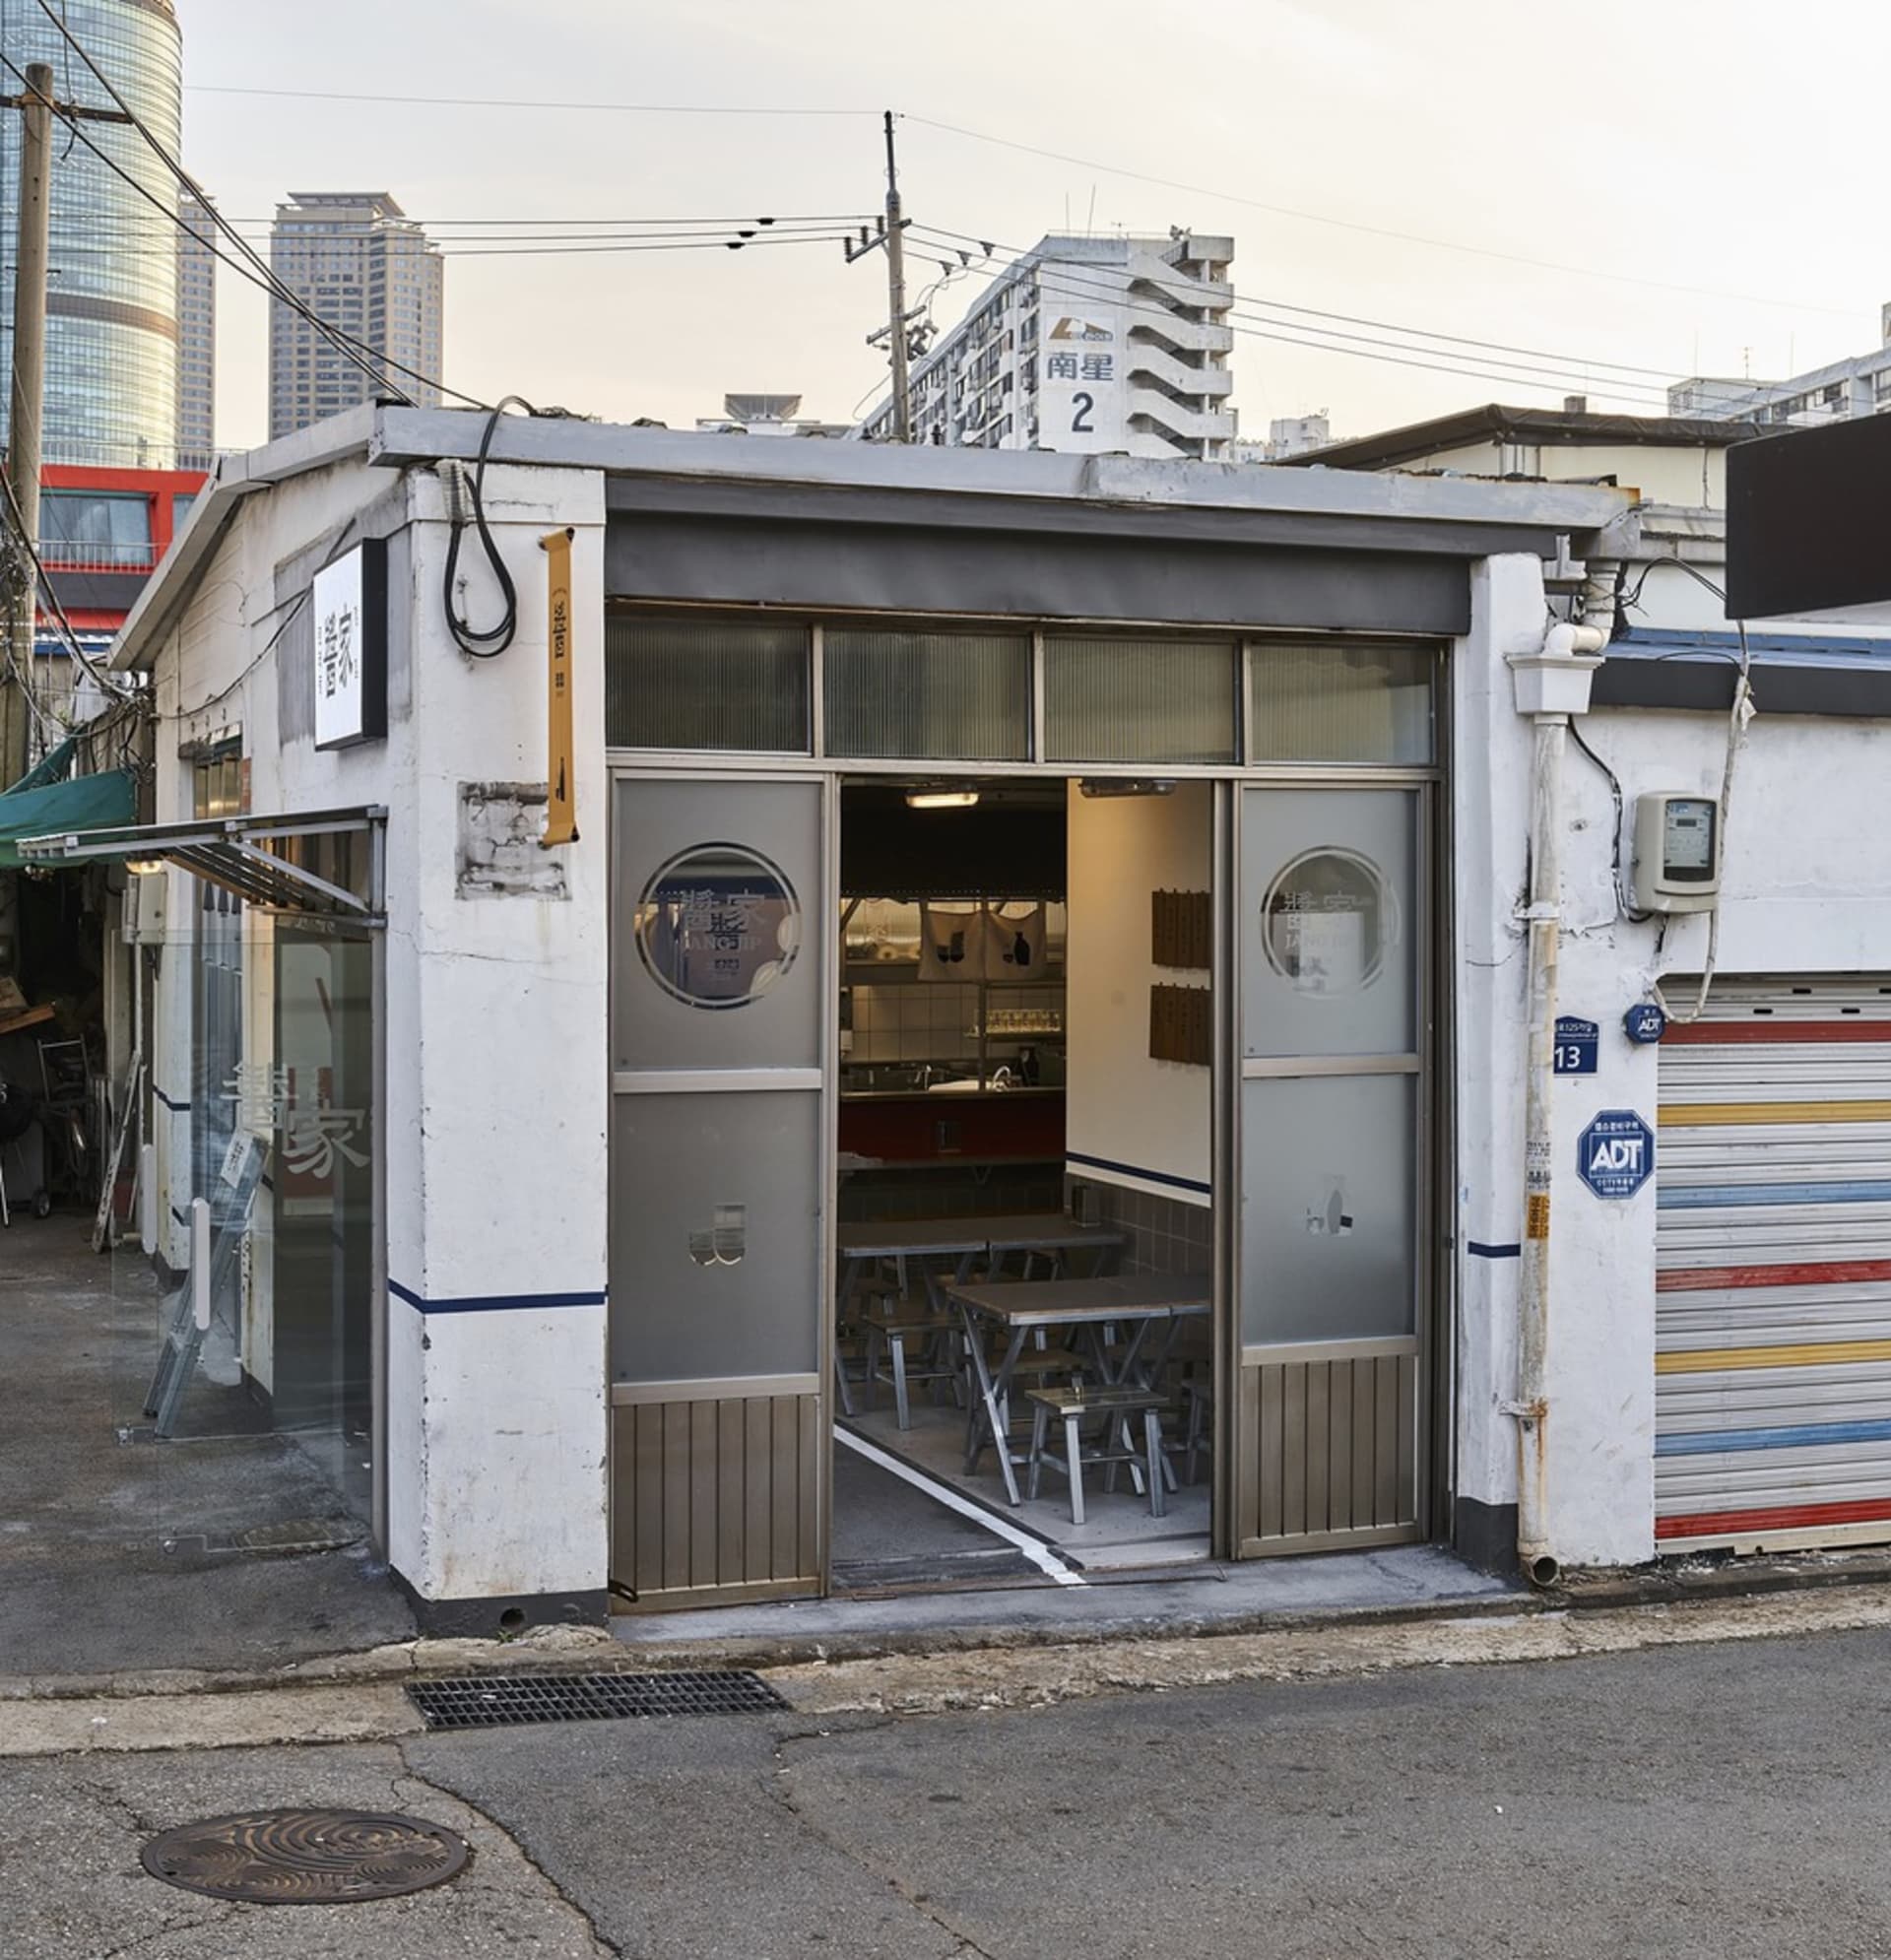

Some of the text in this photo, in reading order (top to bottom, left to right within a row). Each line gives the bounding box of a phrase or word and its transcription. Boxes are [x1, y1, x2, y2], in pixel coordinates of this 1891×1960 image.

[1047, 352, 1114, 381] 南星
[1072, 391, 1094, 432] 2
[1638, 1017, 1661, 1032] ADT
[1554, 1046, 1581, 1069] 13
[1591, 1140, 1643, 1170] ADT
